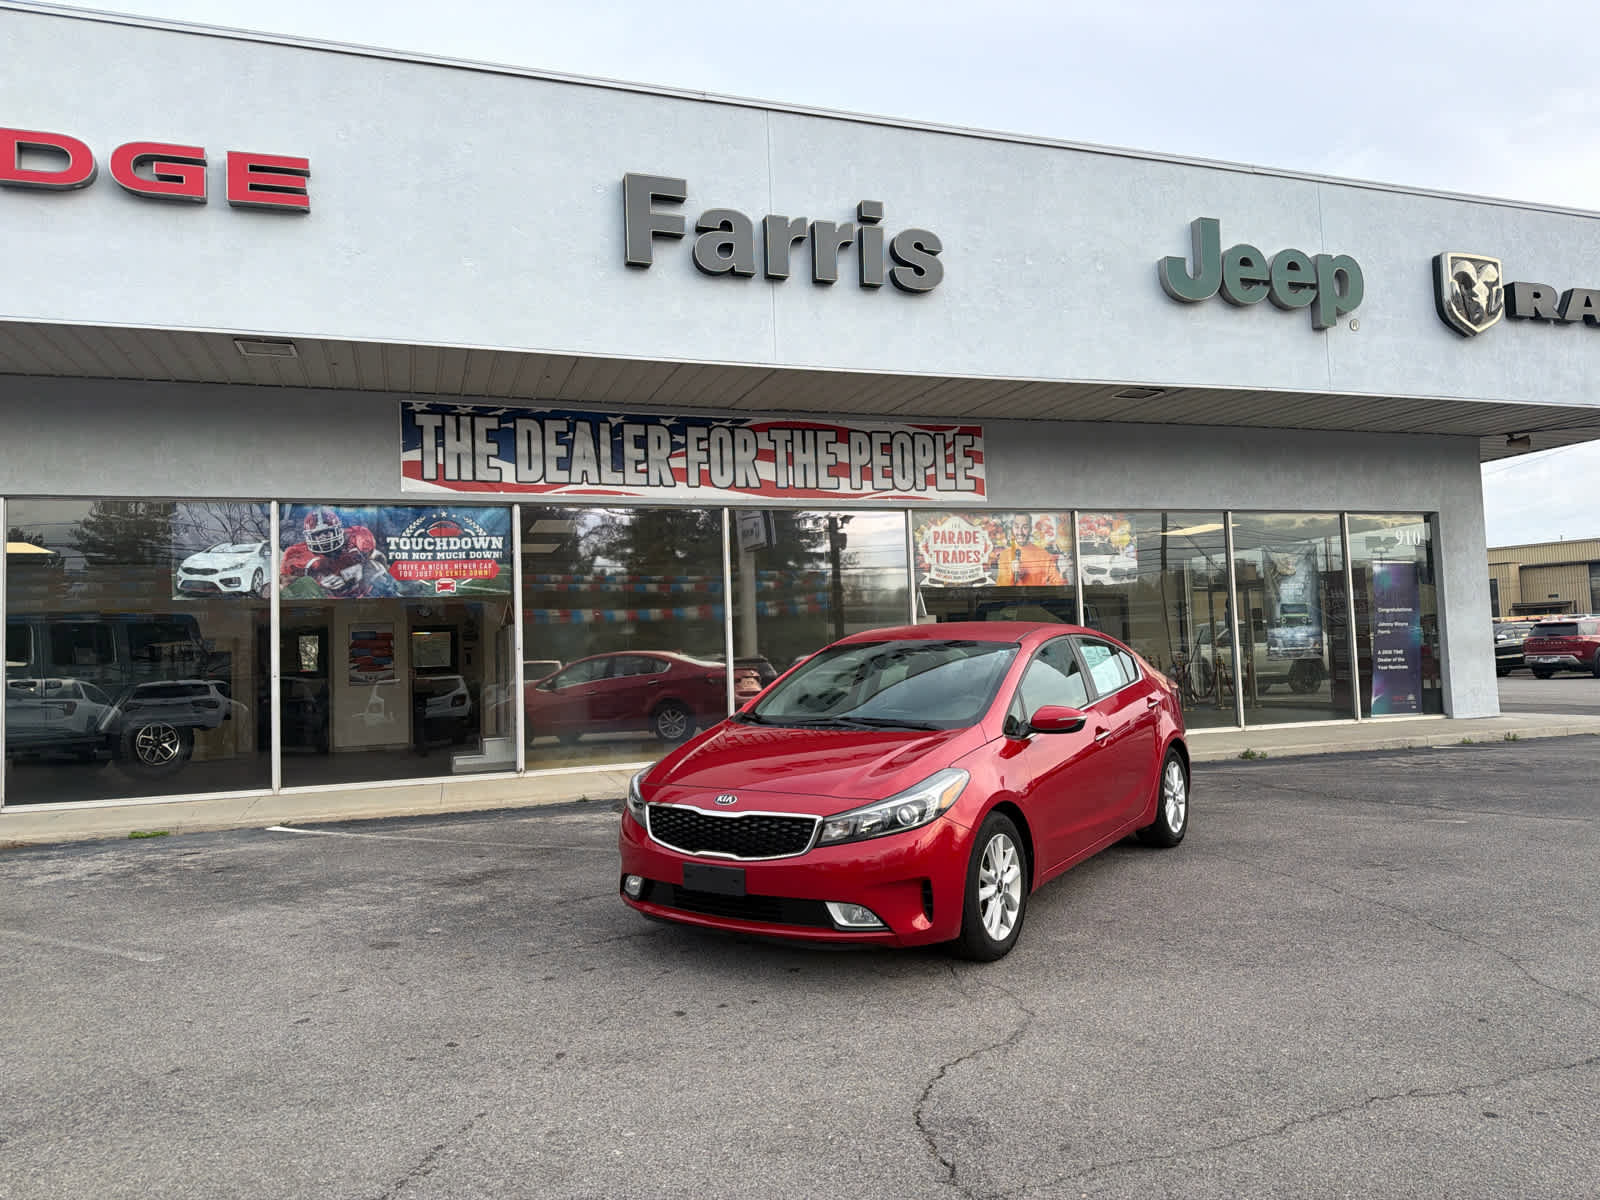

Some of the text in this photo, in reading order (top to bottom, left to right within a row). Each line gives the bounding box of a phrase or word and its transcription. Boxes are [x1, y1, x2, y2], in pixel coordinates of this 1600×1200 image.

[622, 172, 944, 293] Farris
[1158, 217, 1364, 330] Jeep
[415, 413, 977, 492] THE DEALER FOR THE PEOPLE
[386, 536, 504, 551] TOUCHDOWN
[933, 530, 980, 545] PARADE
[1395, 528, 1421, 546] 910
[388, 551, 503, 560] FOR NOT MUCH DOWN!
[933, 550, 981, 565] TRADES
